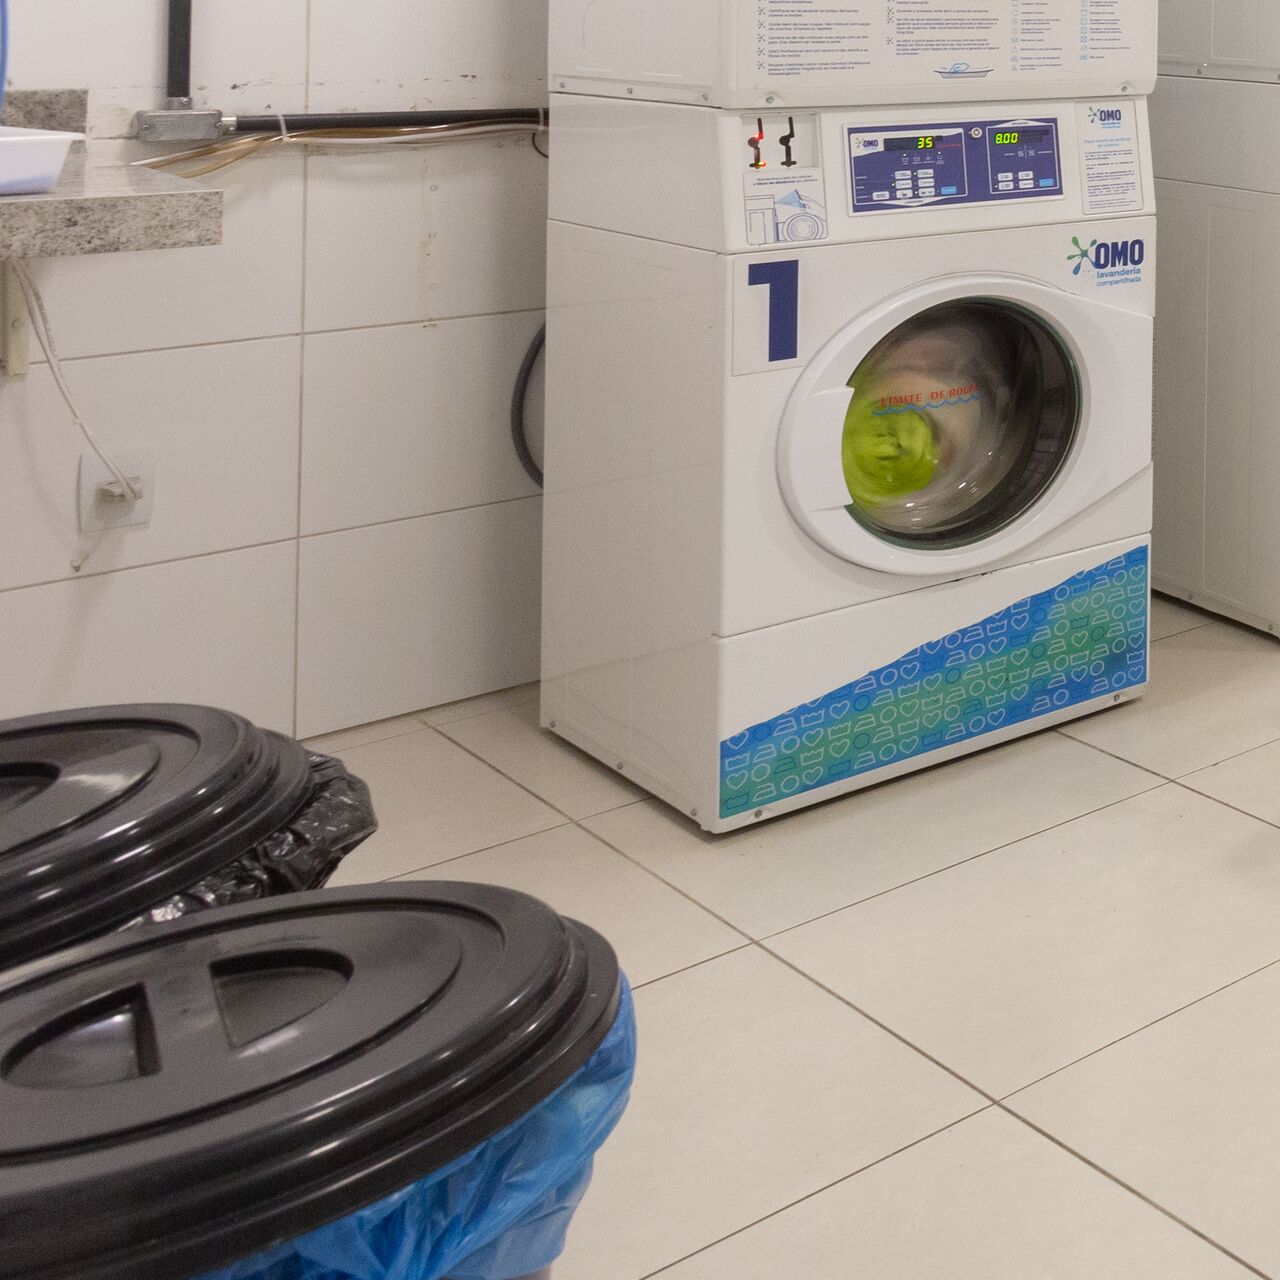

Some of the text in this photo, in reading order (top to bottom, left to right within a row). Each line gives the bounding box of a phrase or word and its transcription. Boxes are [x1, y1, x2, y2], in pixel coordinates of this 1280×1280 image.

[1099, 109, 1122, 122] OMO
[918, 136, 933, 149] 35
[1094, 239, 1144, 269] OMO
[1096, 267, 1142, 278] lavanderia
[1096, 277, 1142, 287] compartilhada
[748, 260, 799, 362] 1
